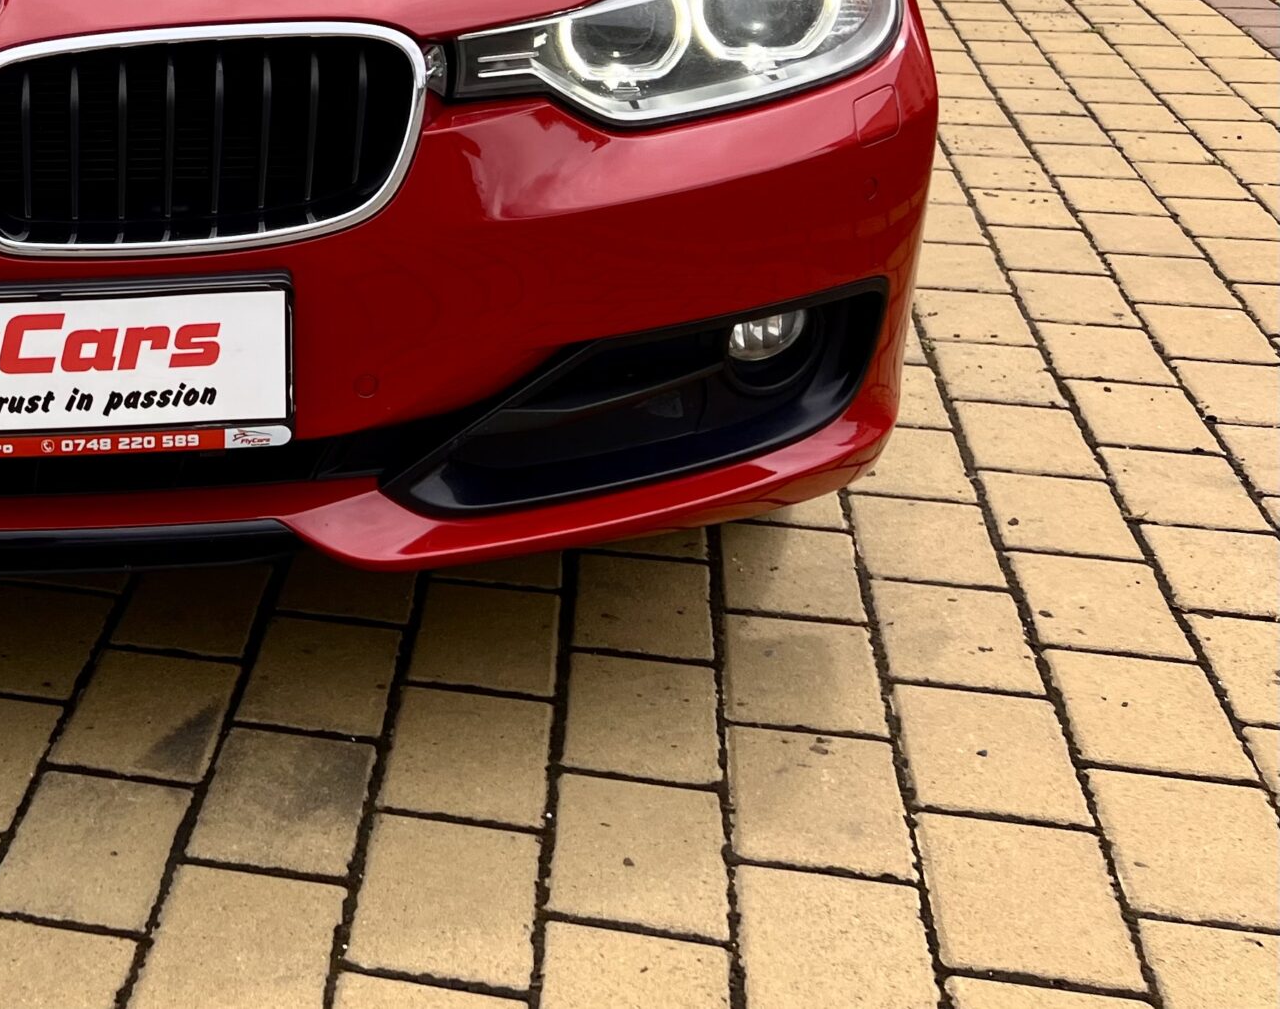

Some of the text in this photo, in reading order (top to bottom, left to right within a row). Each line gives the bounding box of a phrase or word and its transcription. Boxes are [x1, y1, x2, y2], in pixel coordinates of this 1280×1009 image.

[65, 387, 94, 413] in
[102, 383, 218, 416] passion
[61, 433, 200, 452] 0748 220 589
